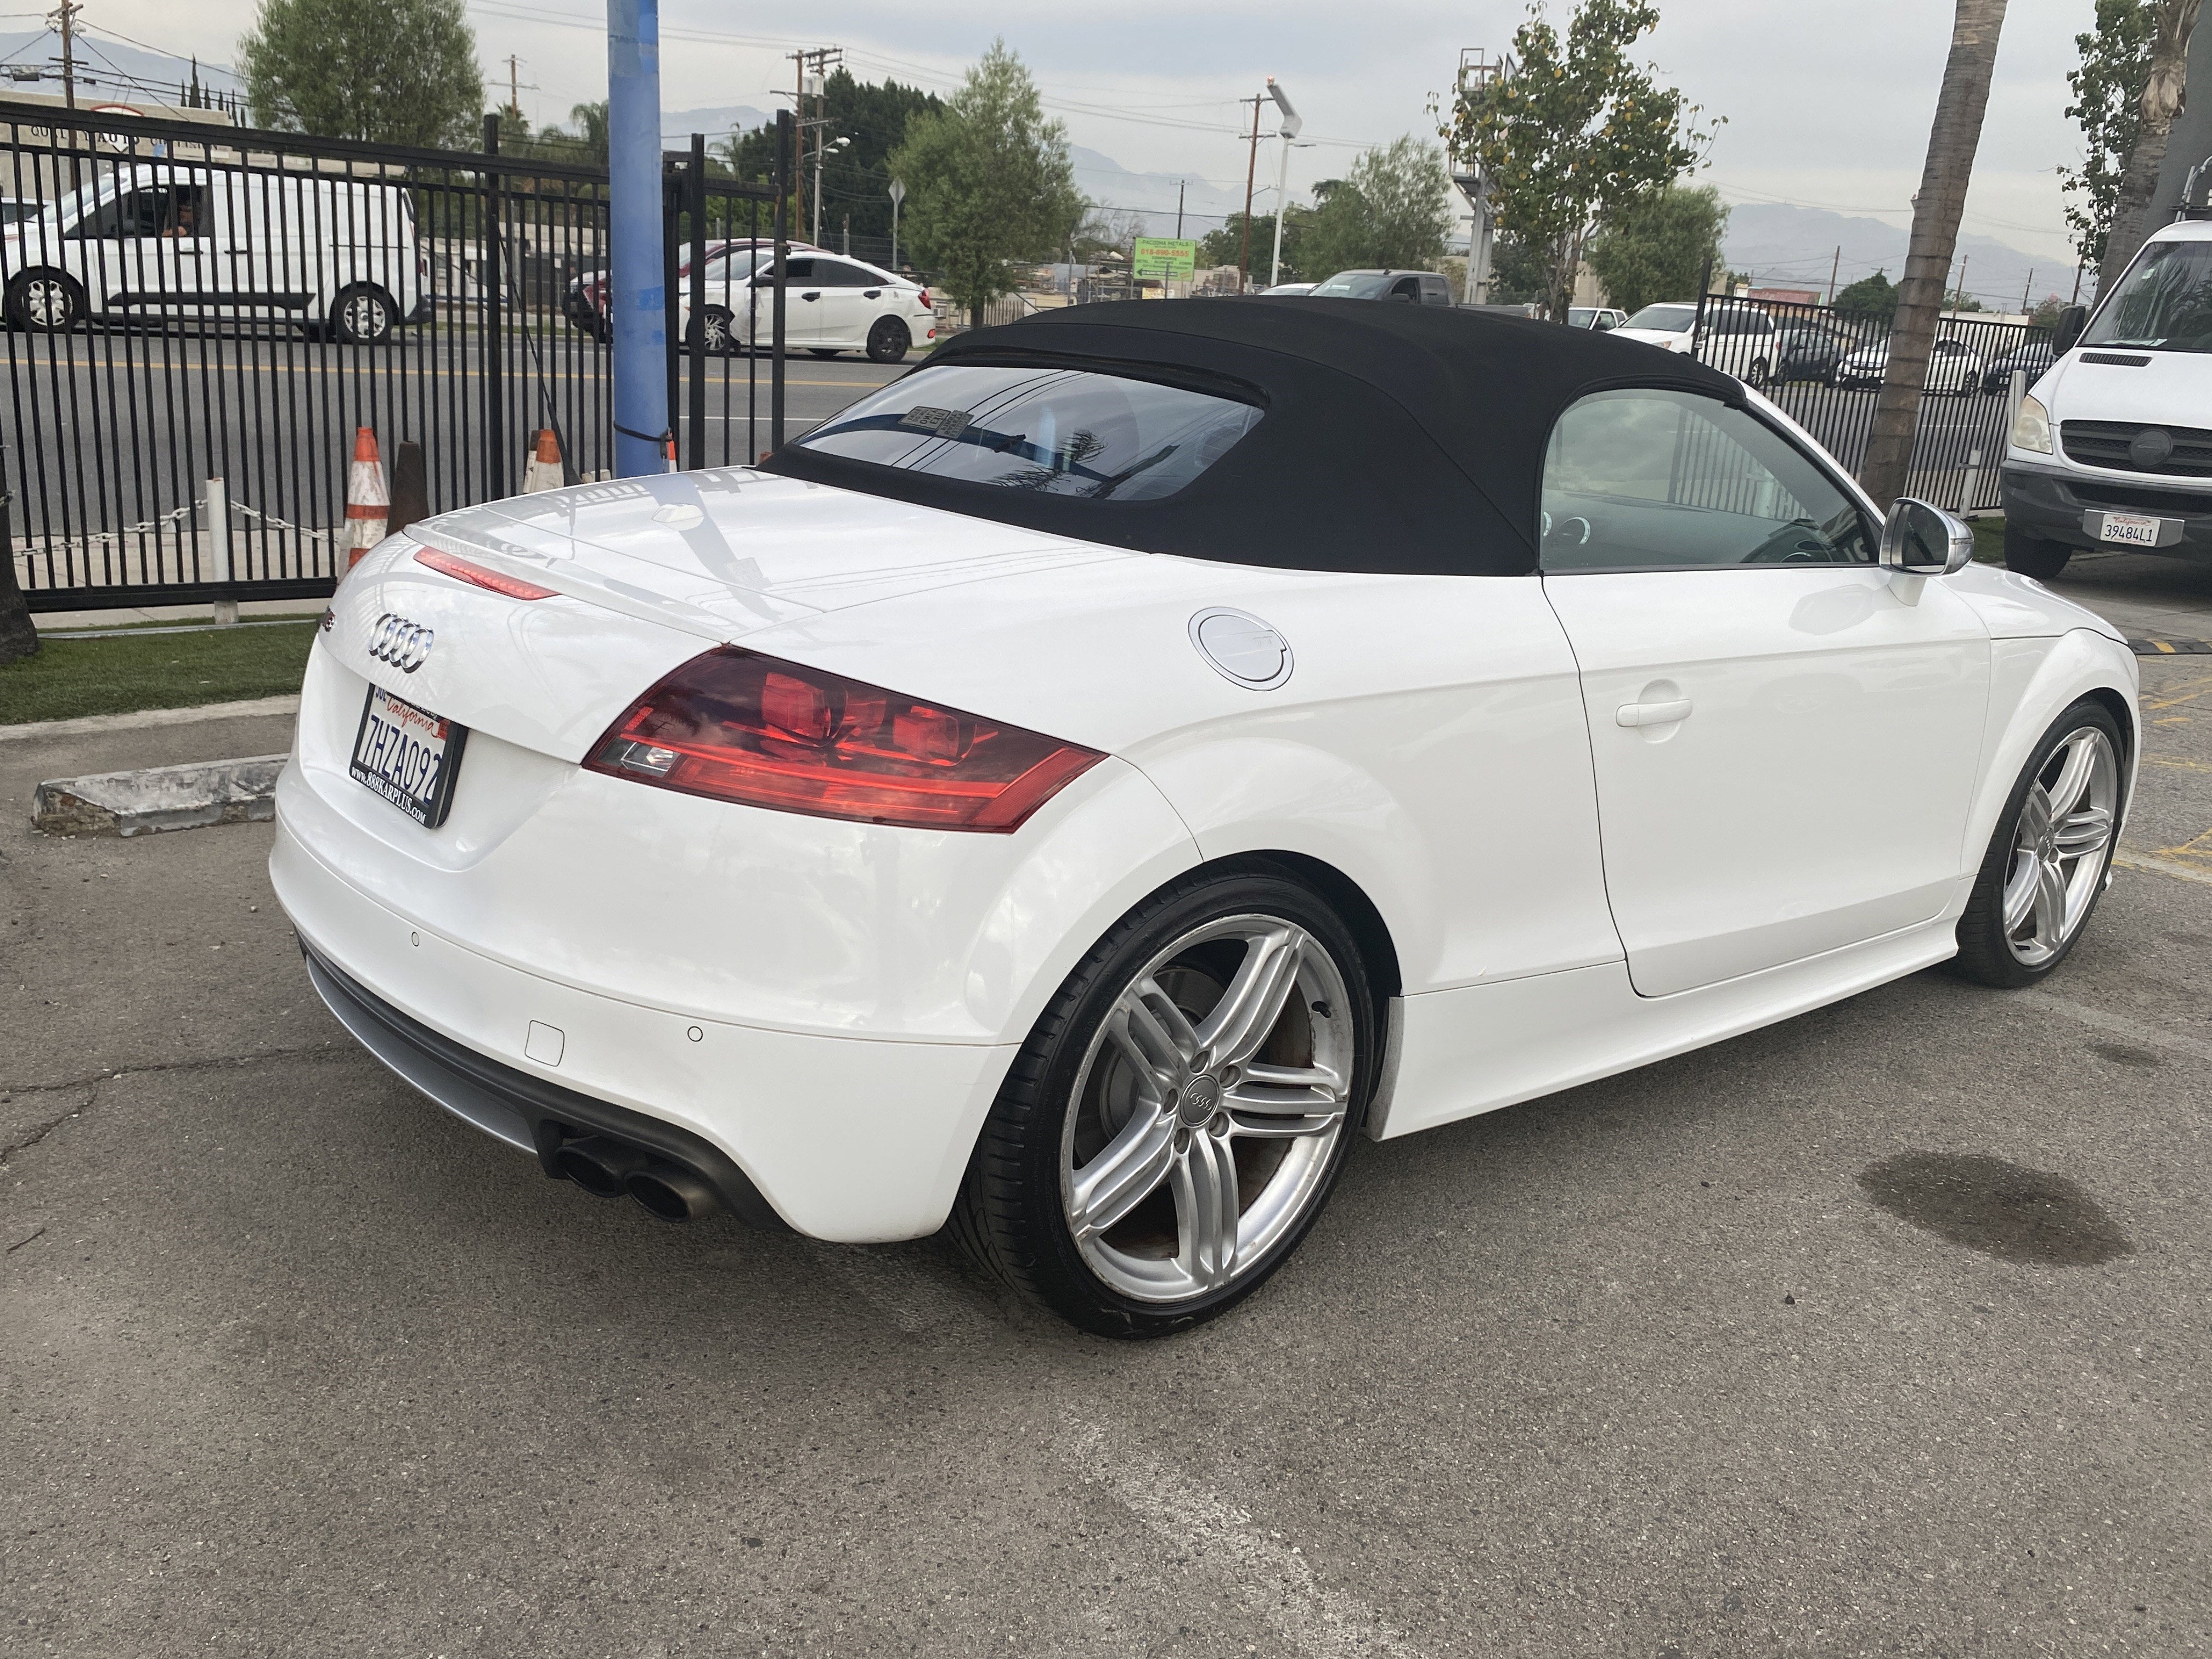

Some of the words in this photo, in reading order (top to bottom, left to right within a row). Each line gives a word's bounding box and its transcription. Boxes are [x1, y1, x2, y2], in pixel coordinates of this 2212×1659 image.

[2104, 524, 2153, 541] 39484L1
[2114, 517, 2149, 526] California
[387, 697, 441, 738] California
[363, 714, 443, 805] 7HZA092
